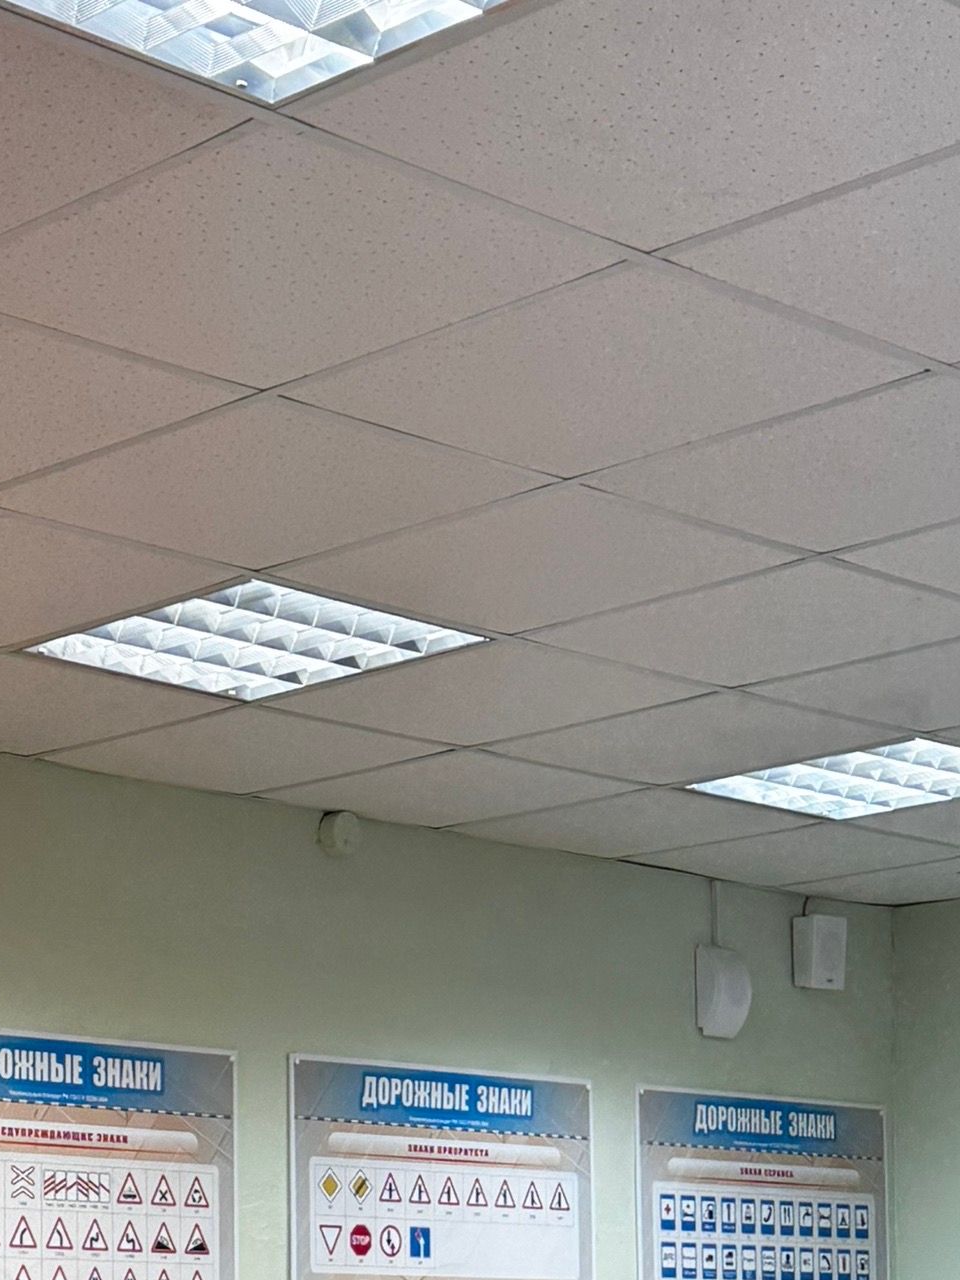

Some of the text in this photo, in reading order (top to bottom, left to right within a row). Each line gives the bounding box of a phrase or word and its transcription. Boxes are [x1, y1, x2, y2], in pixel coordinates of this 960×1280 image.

[92, 1056, 161, 1091] ЗНАКИ
[362, 1076, 532, 1116] ДОРОЖНЫЕ ЗНАКИ
[695, 1104, 835, 1139] ДОРОЖНЫЕ ЗНАКИ
[96, 1133, 128, 1144] ЗНАКИ
[408, 1144, 435, 1153] ЗНАКИ
[352, 1235, 370, 1245] STOP
